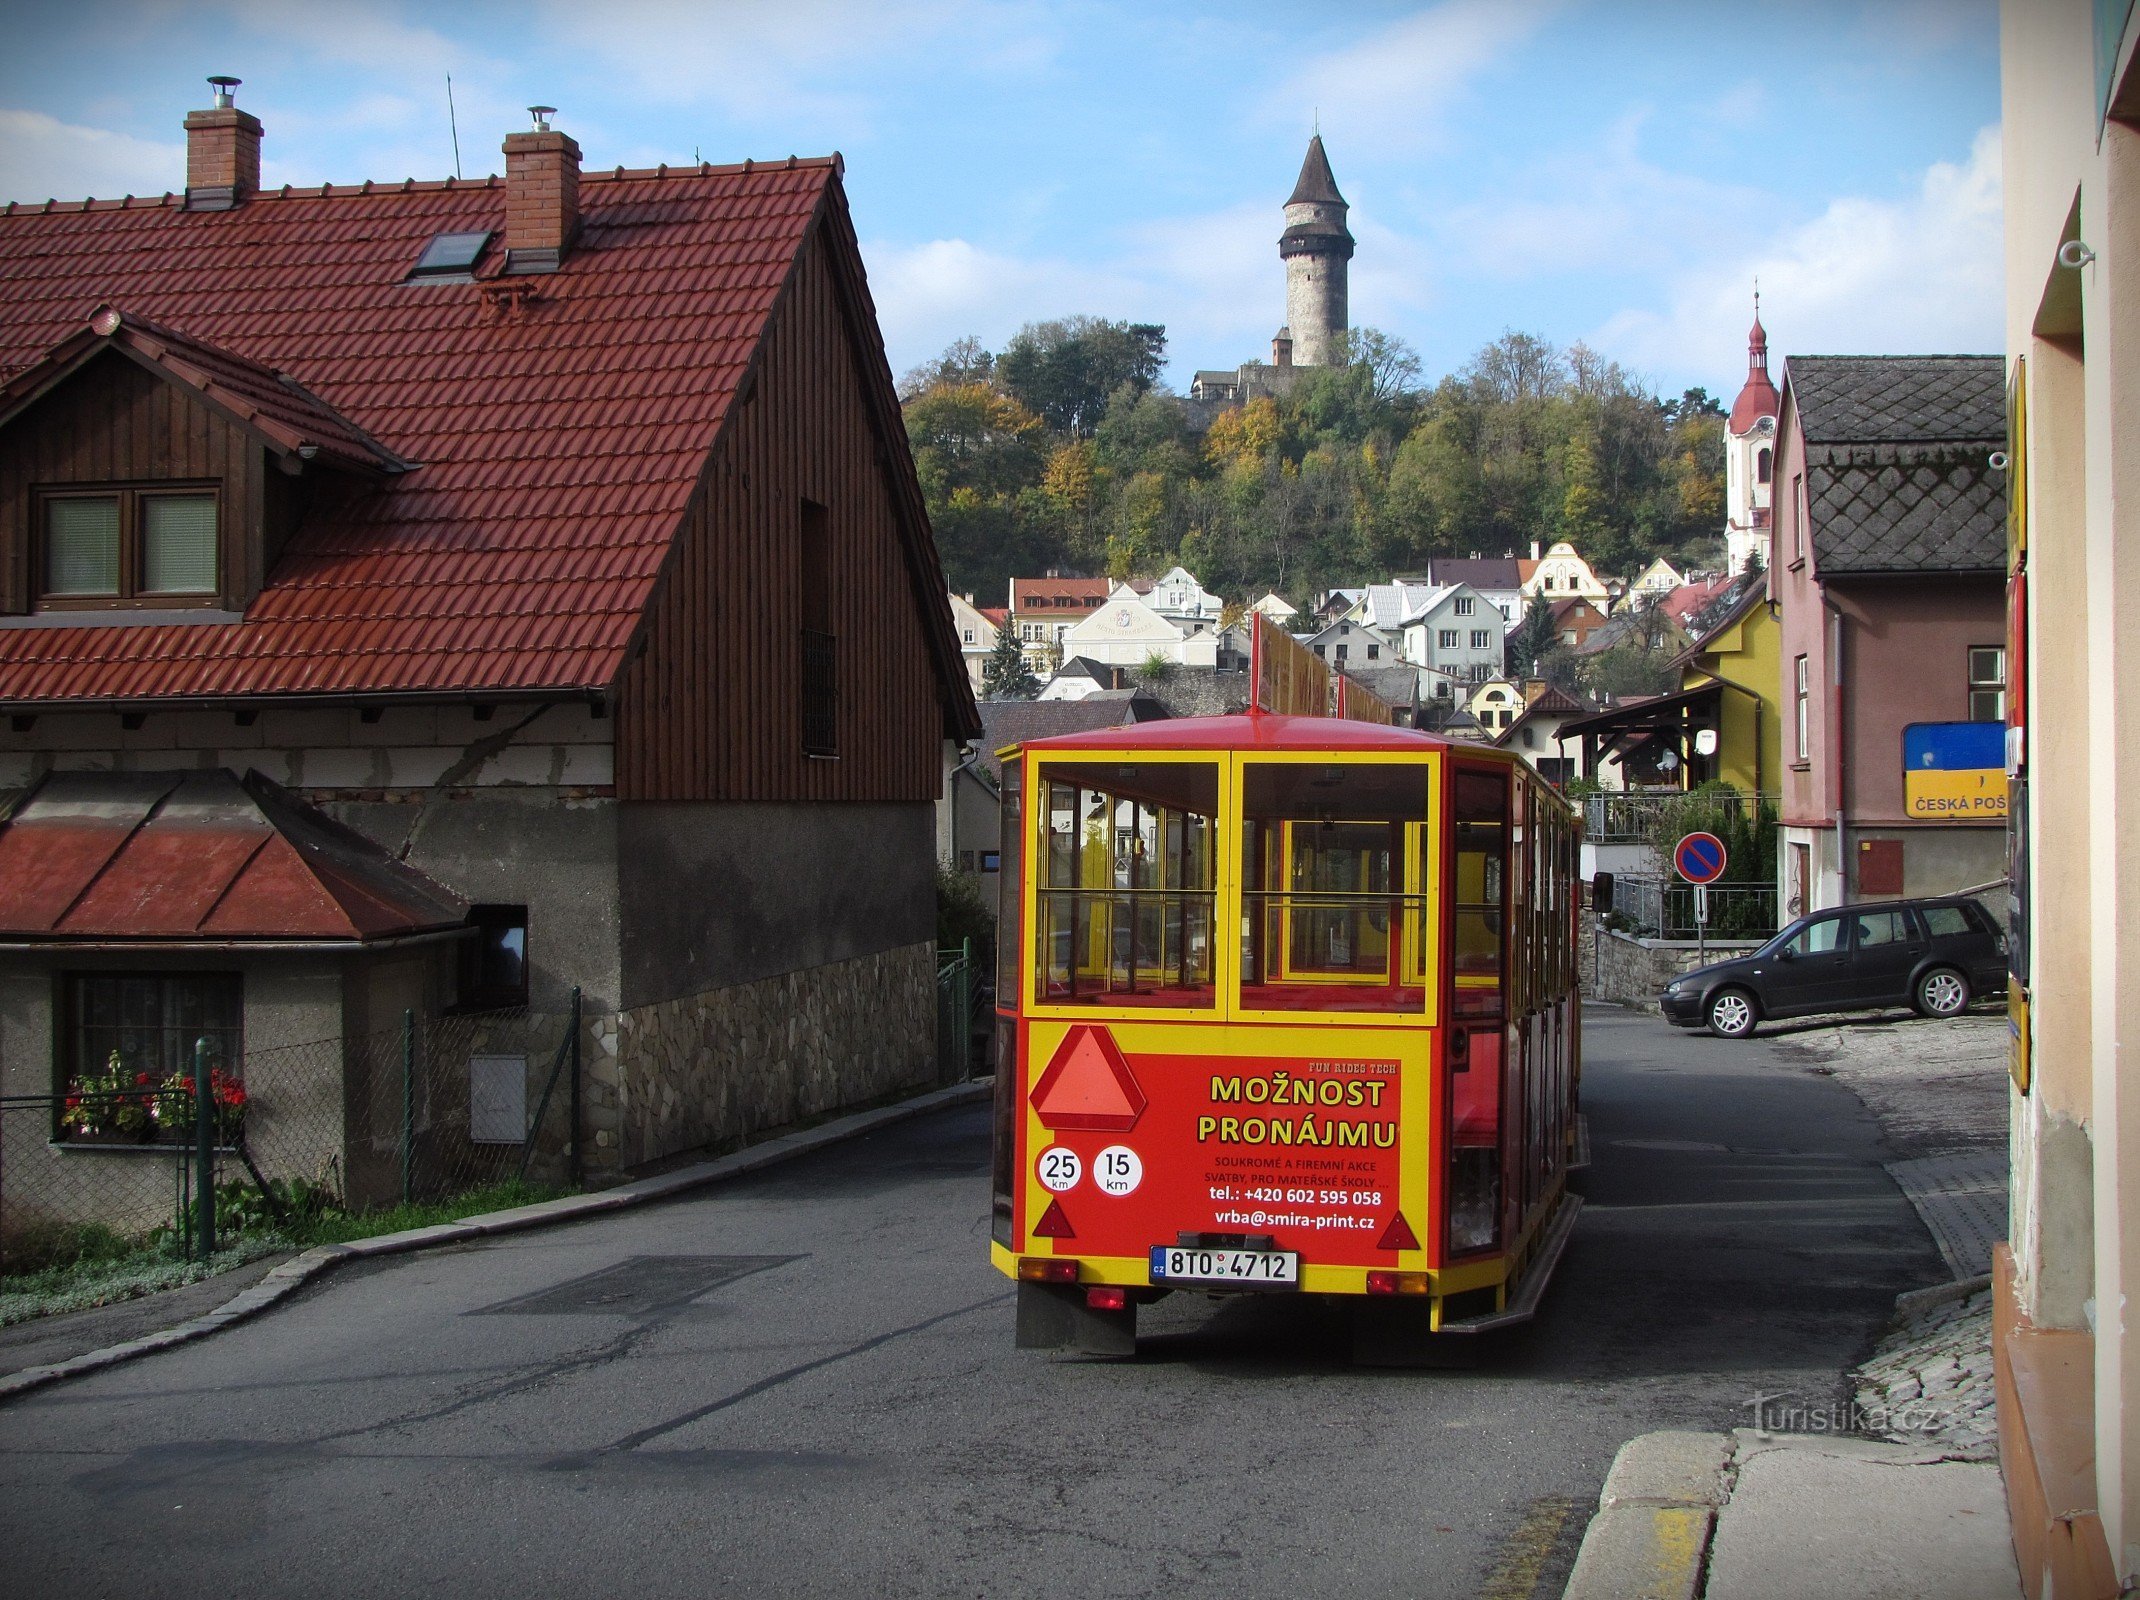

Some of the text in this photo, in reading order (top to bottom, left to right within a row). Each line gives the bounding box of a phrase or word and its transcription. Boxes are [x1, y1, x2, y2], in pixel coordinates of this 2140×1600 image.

[1915, 796, 1969, 811] ČESKÁ
[1308, 1062, 1396, 1074] FUN RIDES TECH
[1210, 1071, 1386, 1107] MOŽNOST
[1198, 1113, 1397, 1148] PRONÁJMU
[1046, 1155, 1075, 1178] 25
[1106, 1153, 1130, 1176] 15
[1215, 1156, 1377, 1172] SOUKROMÉ A FIREMNÍ AKCE
[1052, 1179, 1069, 1189] km
[1106, 1179, 1128, 1190] km
[1204, 1172, 1248, 1185] SVATBY,
[1251, 1175, 1275, 1184] PRO
[1277, 1173, 1338, 1186] MATEŘSKÉ
[1341, 1175, 1376, 1187] ŠKOLY
[1209, 1186, 1382, 1206] tel.: +420 602 595 058
[1215, 1209, 1375, 1230] vrba@smira-print.cz
[1153, 1265, 1165, 1273] CZ
[1230, 1254, 1286, 1278] 4712
